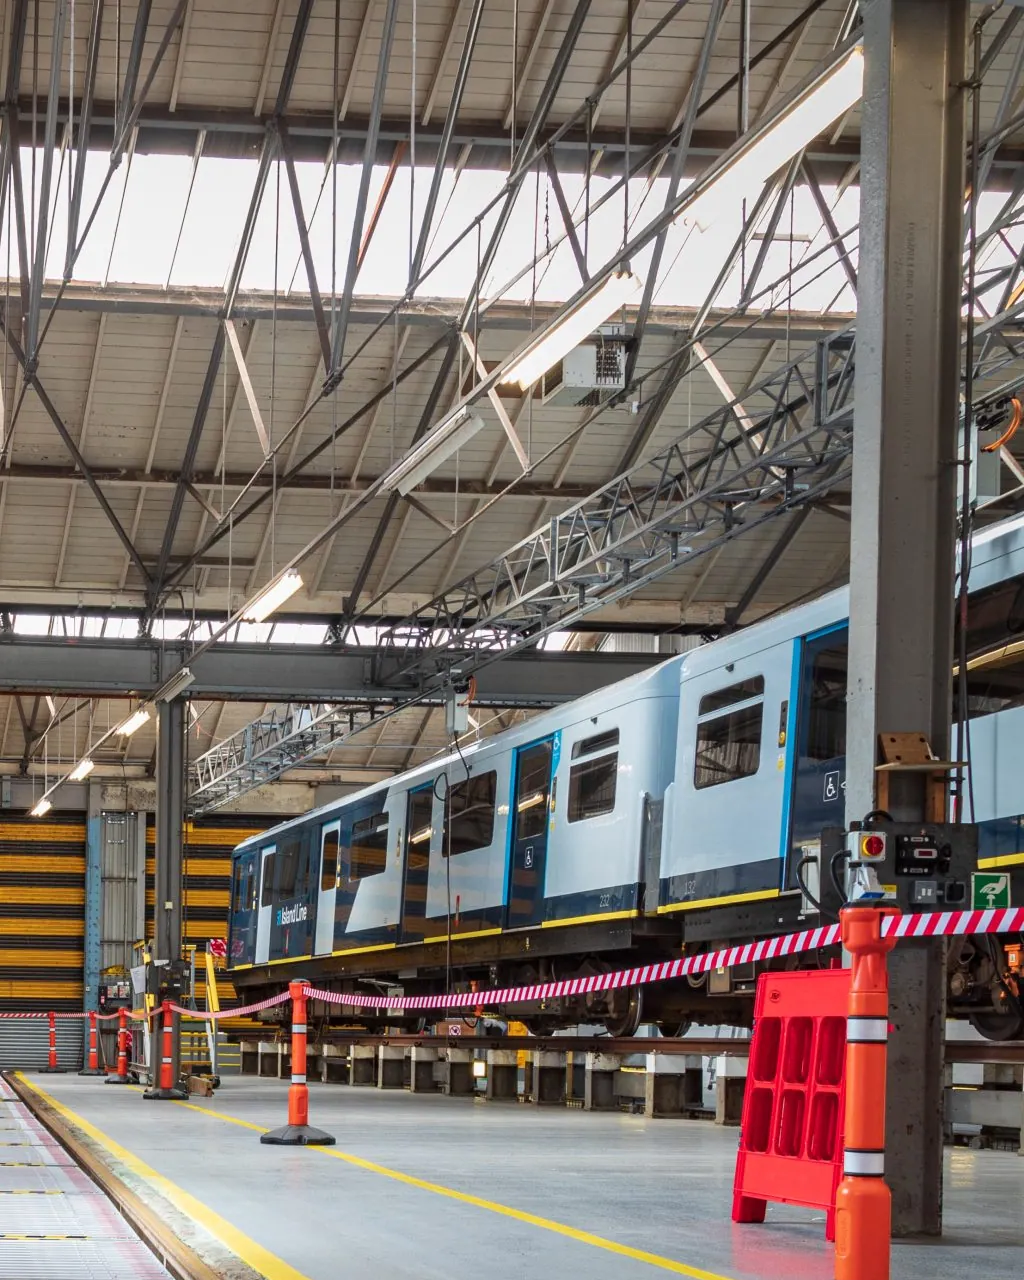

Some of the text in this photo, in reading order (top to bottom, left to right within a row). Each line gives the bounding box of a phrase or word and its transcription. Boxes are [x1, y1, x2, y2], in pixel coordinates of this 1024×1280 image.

[684, 880, 696, 895] 132
[599, 894, 610, 908] 232
[282, 902, 308, 925] Island Line
